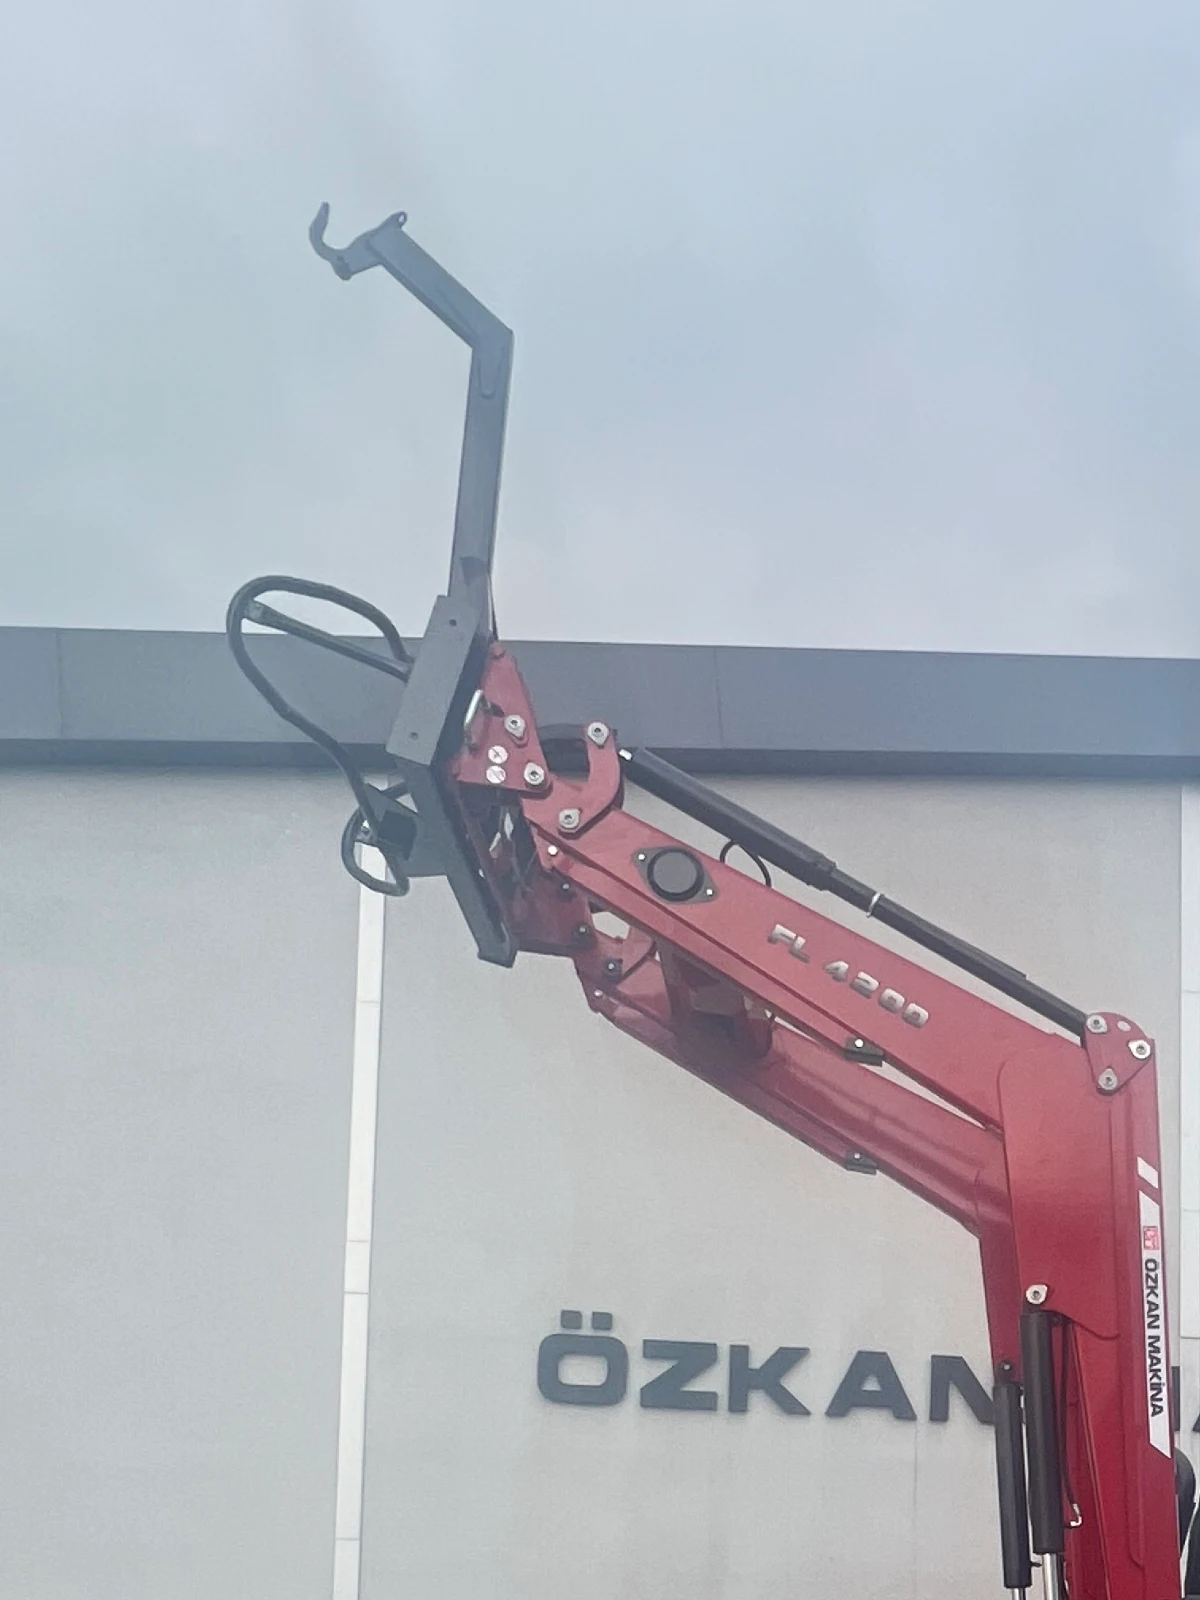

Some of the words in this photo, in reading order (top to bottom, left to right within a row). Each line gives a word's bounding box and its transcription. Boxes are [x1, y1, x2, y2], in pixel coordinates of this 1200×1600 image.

[767, 923, 809, 963] FL
[824, 960, 930, 1028] 4200
[1144, 1258, 1161, 1330] ÖZKAN
[1147, 1335, 1166, 1418] MAKİNA
